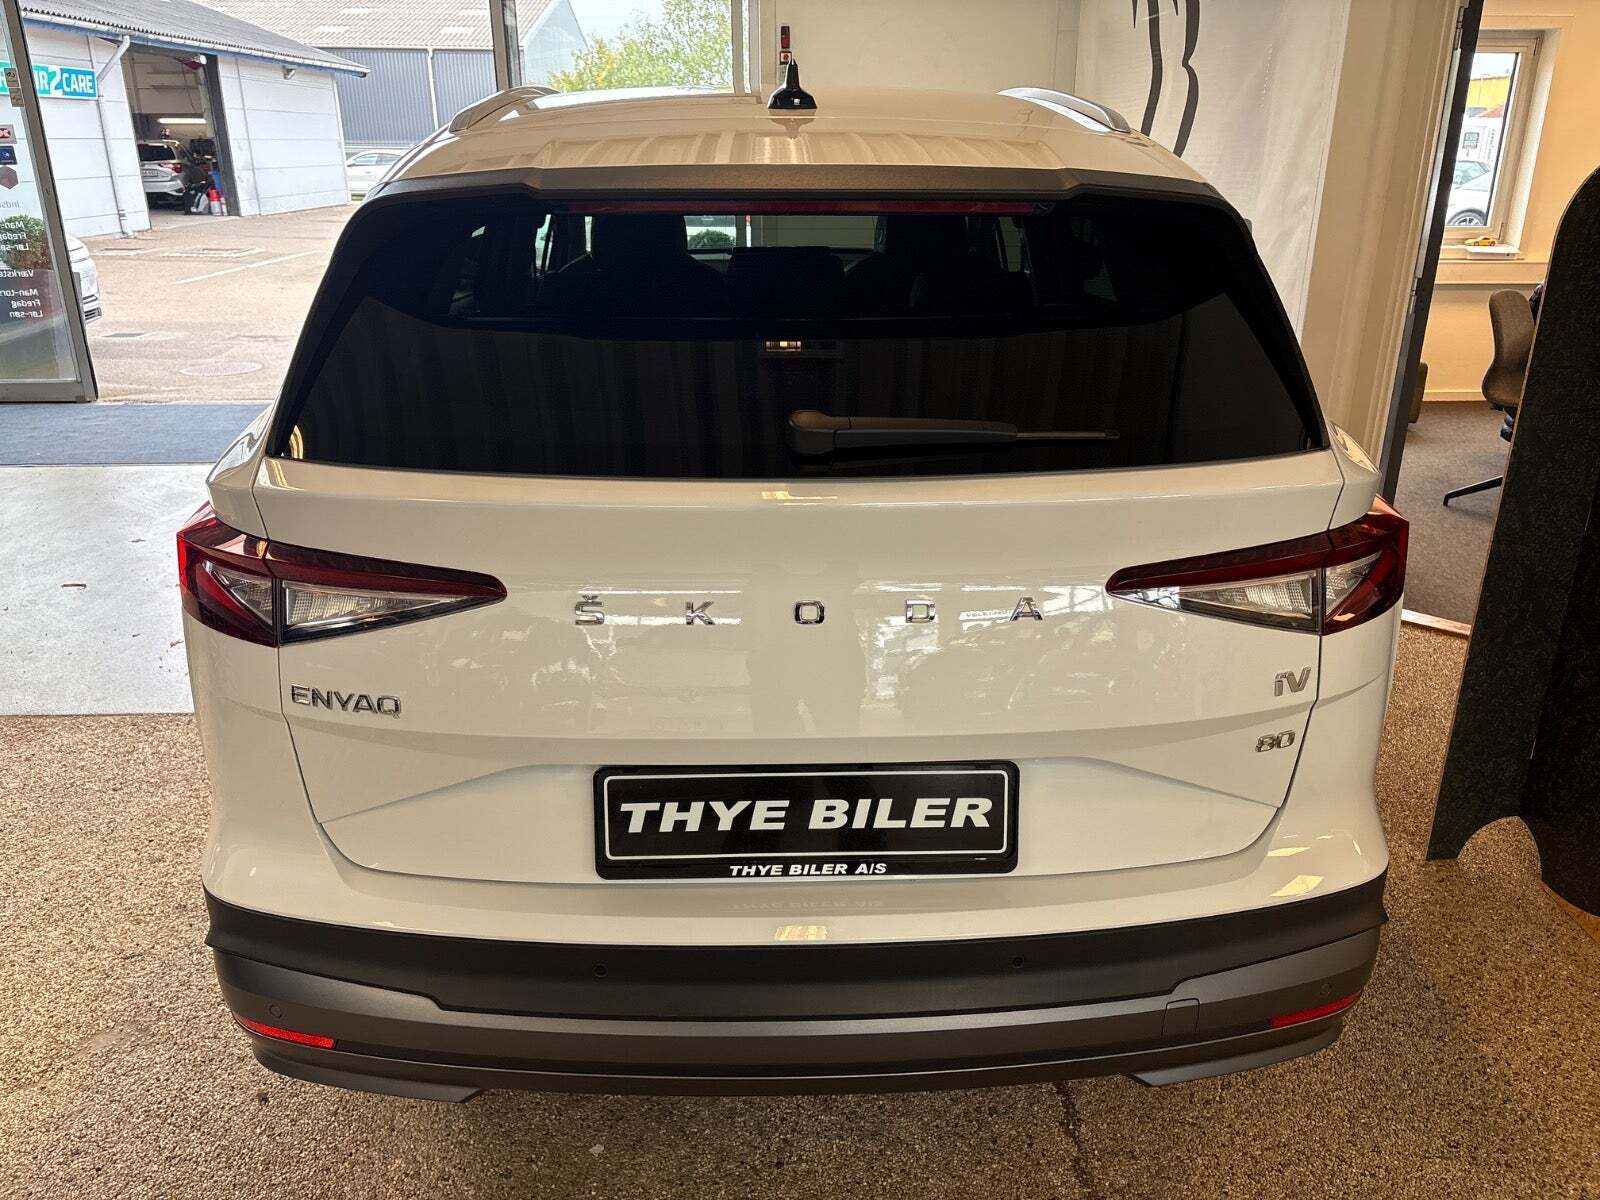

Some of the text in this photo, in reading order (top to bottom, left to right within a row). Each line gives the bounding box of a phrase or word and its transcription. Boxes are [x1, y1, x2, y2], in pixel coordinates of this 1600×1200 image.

[574, 594, 1043, 626] ŠKODA
[291, 683, 402, 719] ENYAQ
[1255, 730, 1296, 752] 80
[620, 797, 993, 833] THYE BILER
[729, 863, 887, 876] THYE BILER A/S
